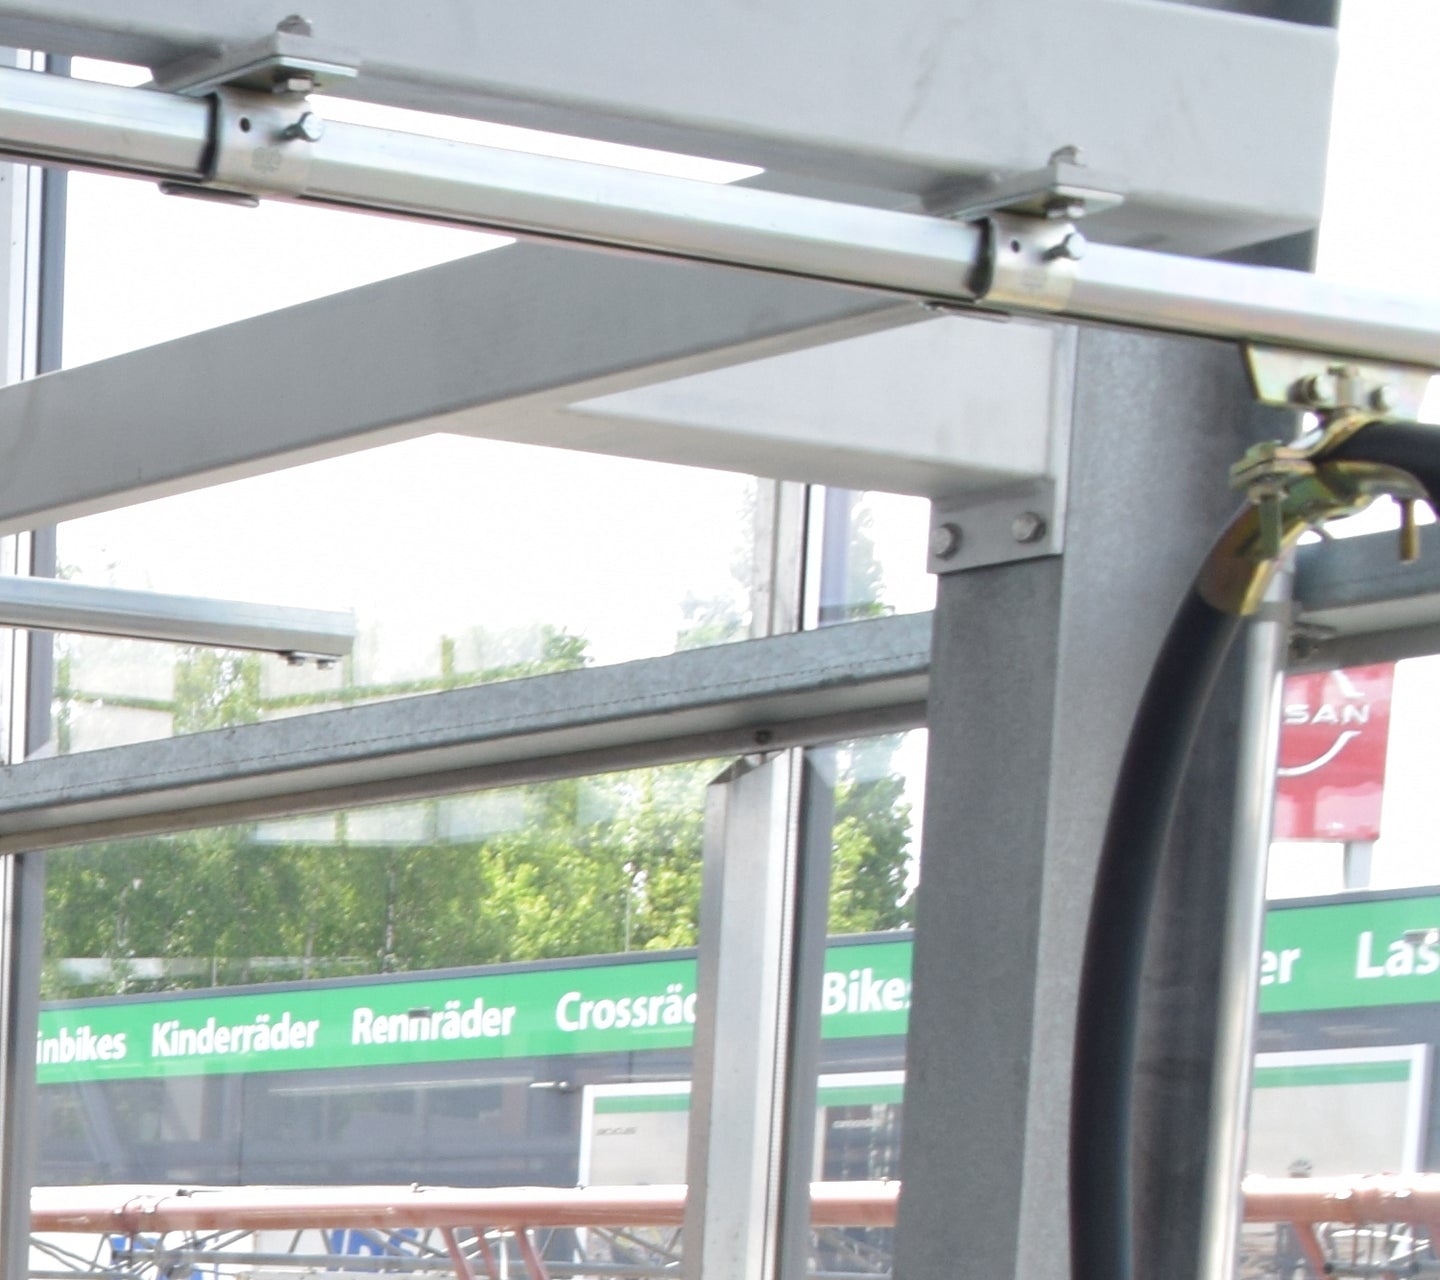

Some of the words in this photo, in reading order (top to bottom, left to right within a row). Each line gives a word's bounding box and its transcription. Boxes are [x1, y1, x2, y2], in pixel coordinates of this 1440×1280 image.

[1283, 704, 1371, 726] SAN
[35, 1025, 128, 1063] inbikes
[150, 1012, 321, 1058] Kinderräder
[351, 997, 516, 1046] Rennräder
